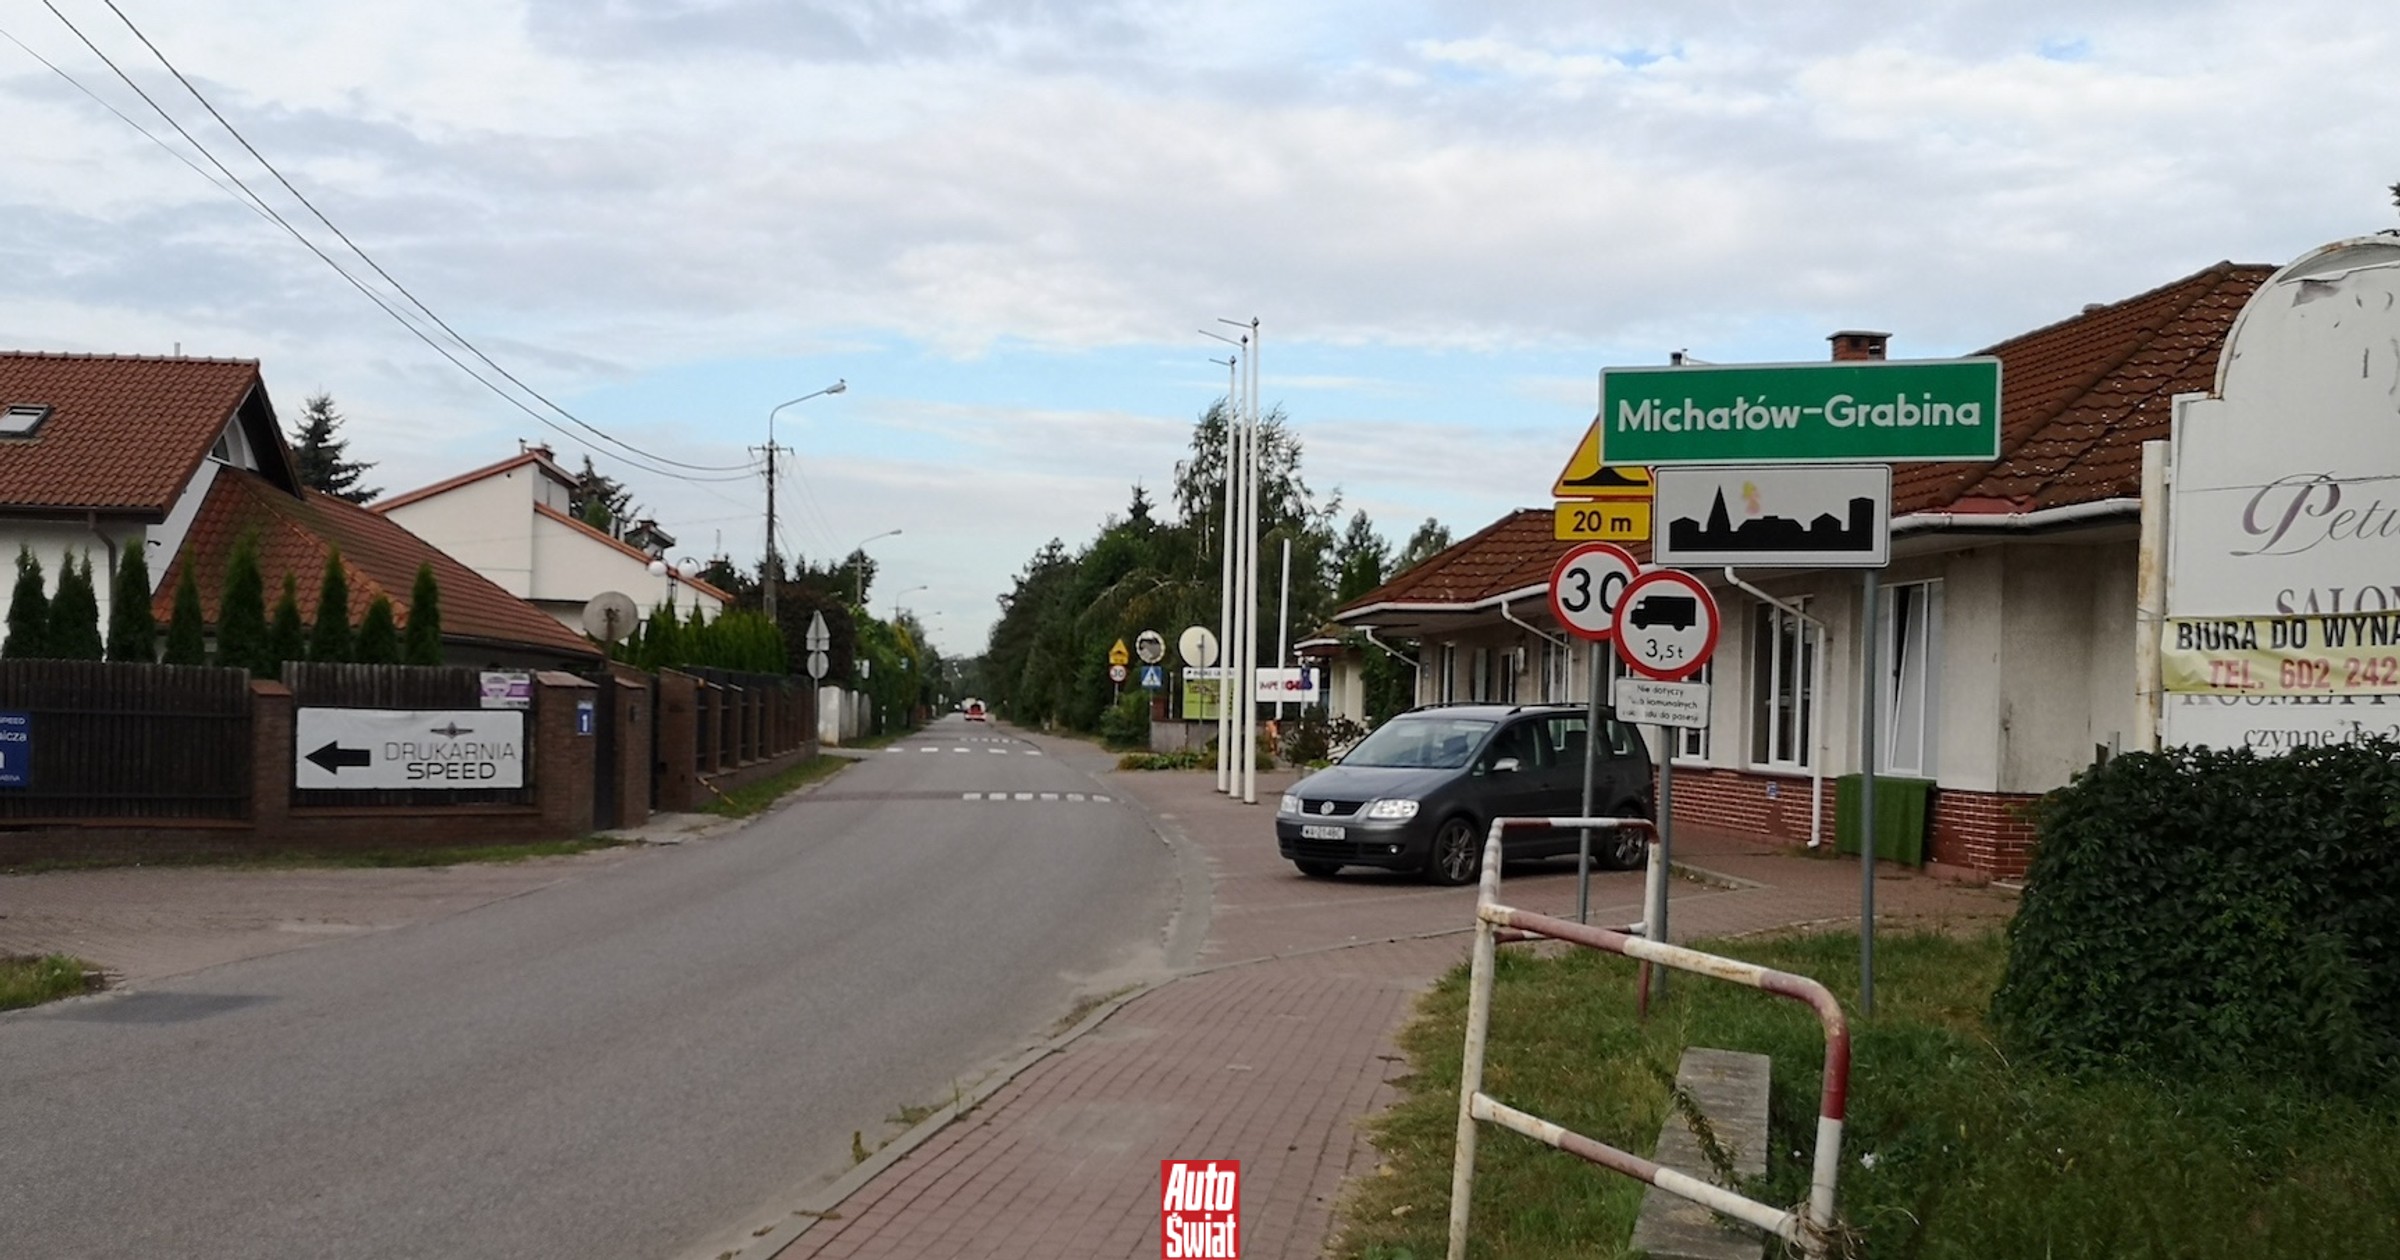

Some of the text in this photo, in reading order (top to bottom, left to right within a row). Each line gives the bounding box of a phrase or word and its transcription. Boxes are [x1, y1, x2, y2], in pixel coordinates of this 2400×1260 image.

[1617, 392, 1981, 432] Michałów-Grabina
[1573, 510, 1632, 533] 20 m
[1562, 567, 1628, 614] 30
[2176, 621, 2258, 650] BIURA
[2271, 618, 2307, 649] DO
[2209, 656, 2398, 689] TEL. 602 242
[385, 742, 516, 761] DRUKARNIA
[407, 763, 496, 780] SPEED
